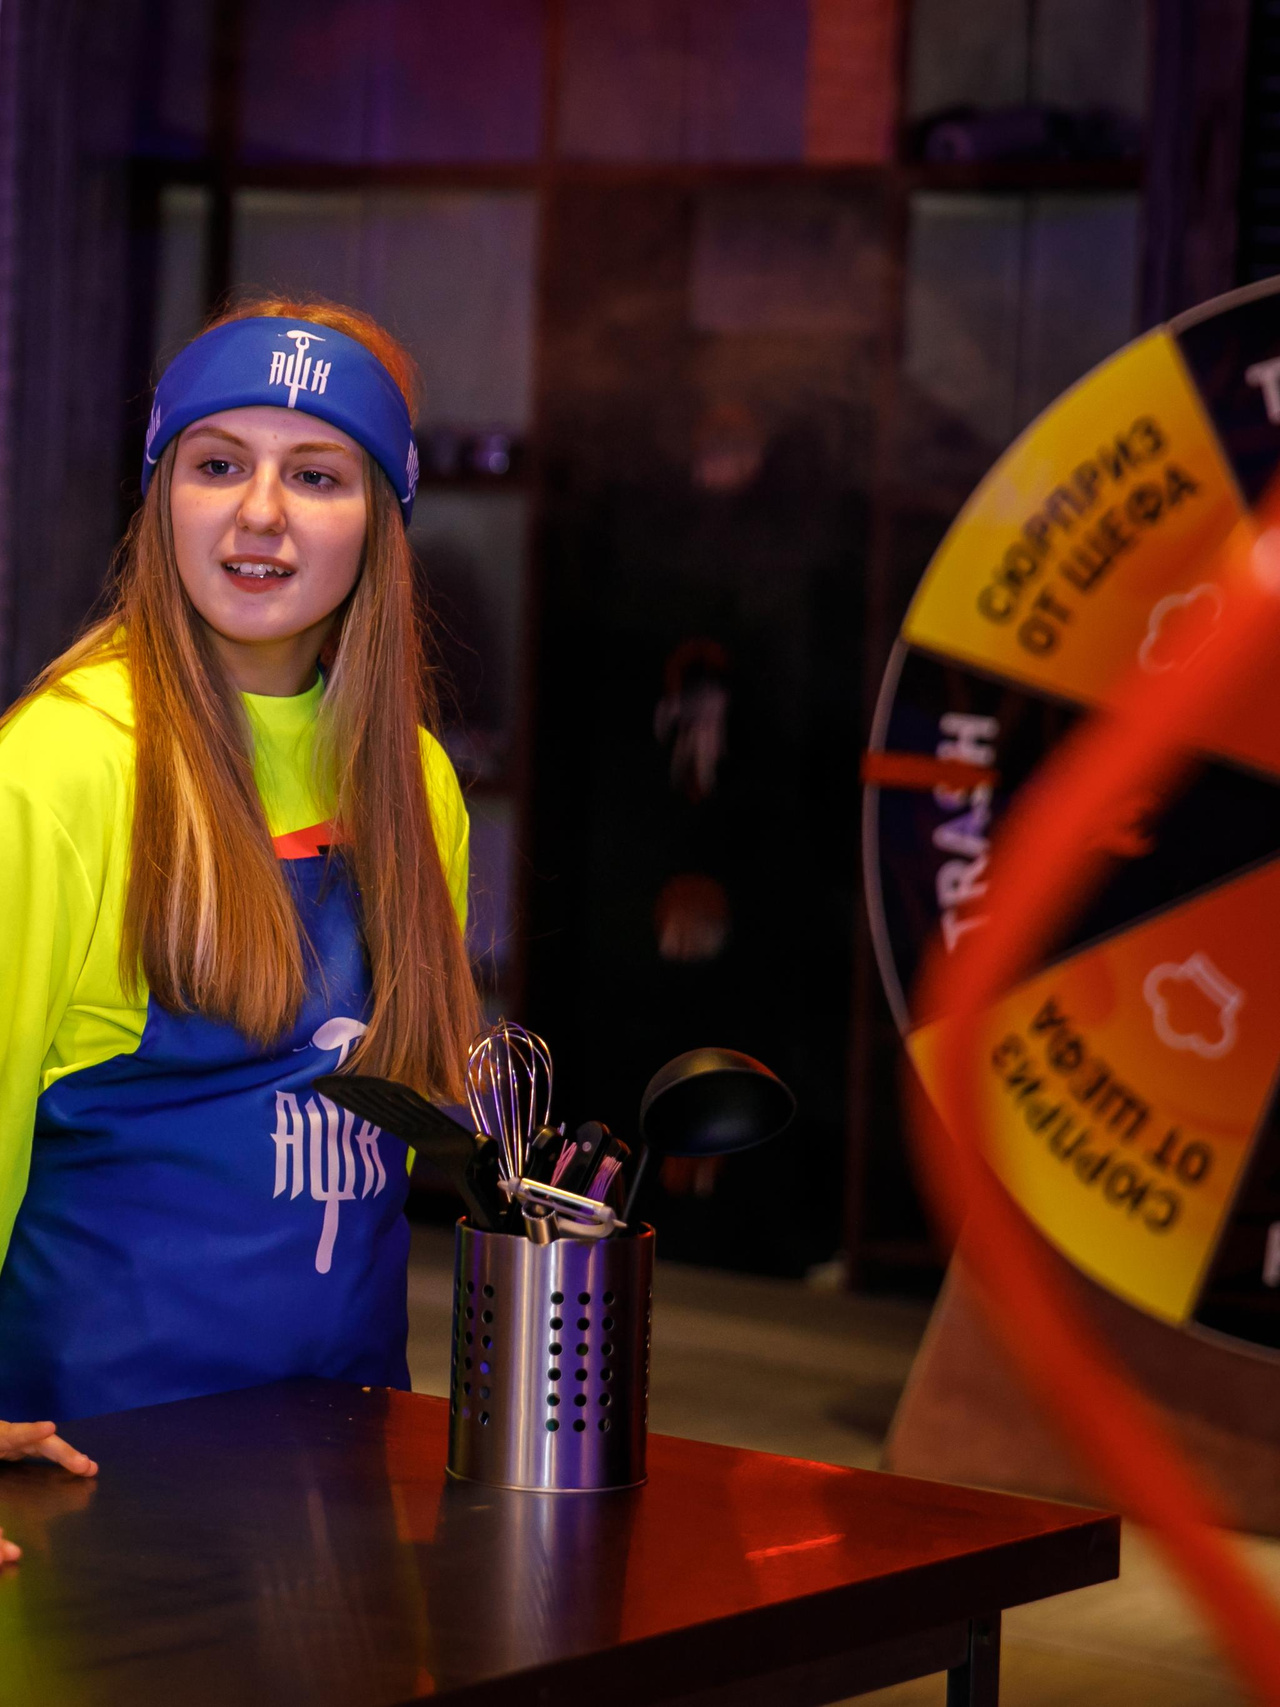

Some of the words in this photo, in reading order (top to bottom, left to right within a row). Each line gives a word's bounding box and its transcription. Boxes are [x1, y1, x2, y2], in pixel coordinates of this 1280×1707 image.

[976, 415, 1166, 626] СЮРПРИЗ
[1017, 588, 1073, 658] ОТ
[1057, 464, 1200, 595] ШЕФА
[991, 1033, 1184, 1237] СЮРПРИЗ
[1030, 998, 1152, 1142] ШЕФА
[1150, 1130, 1213, 1188] ОТ
